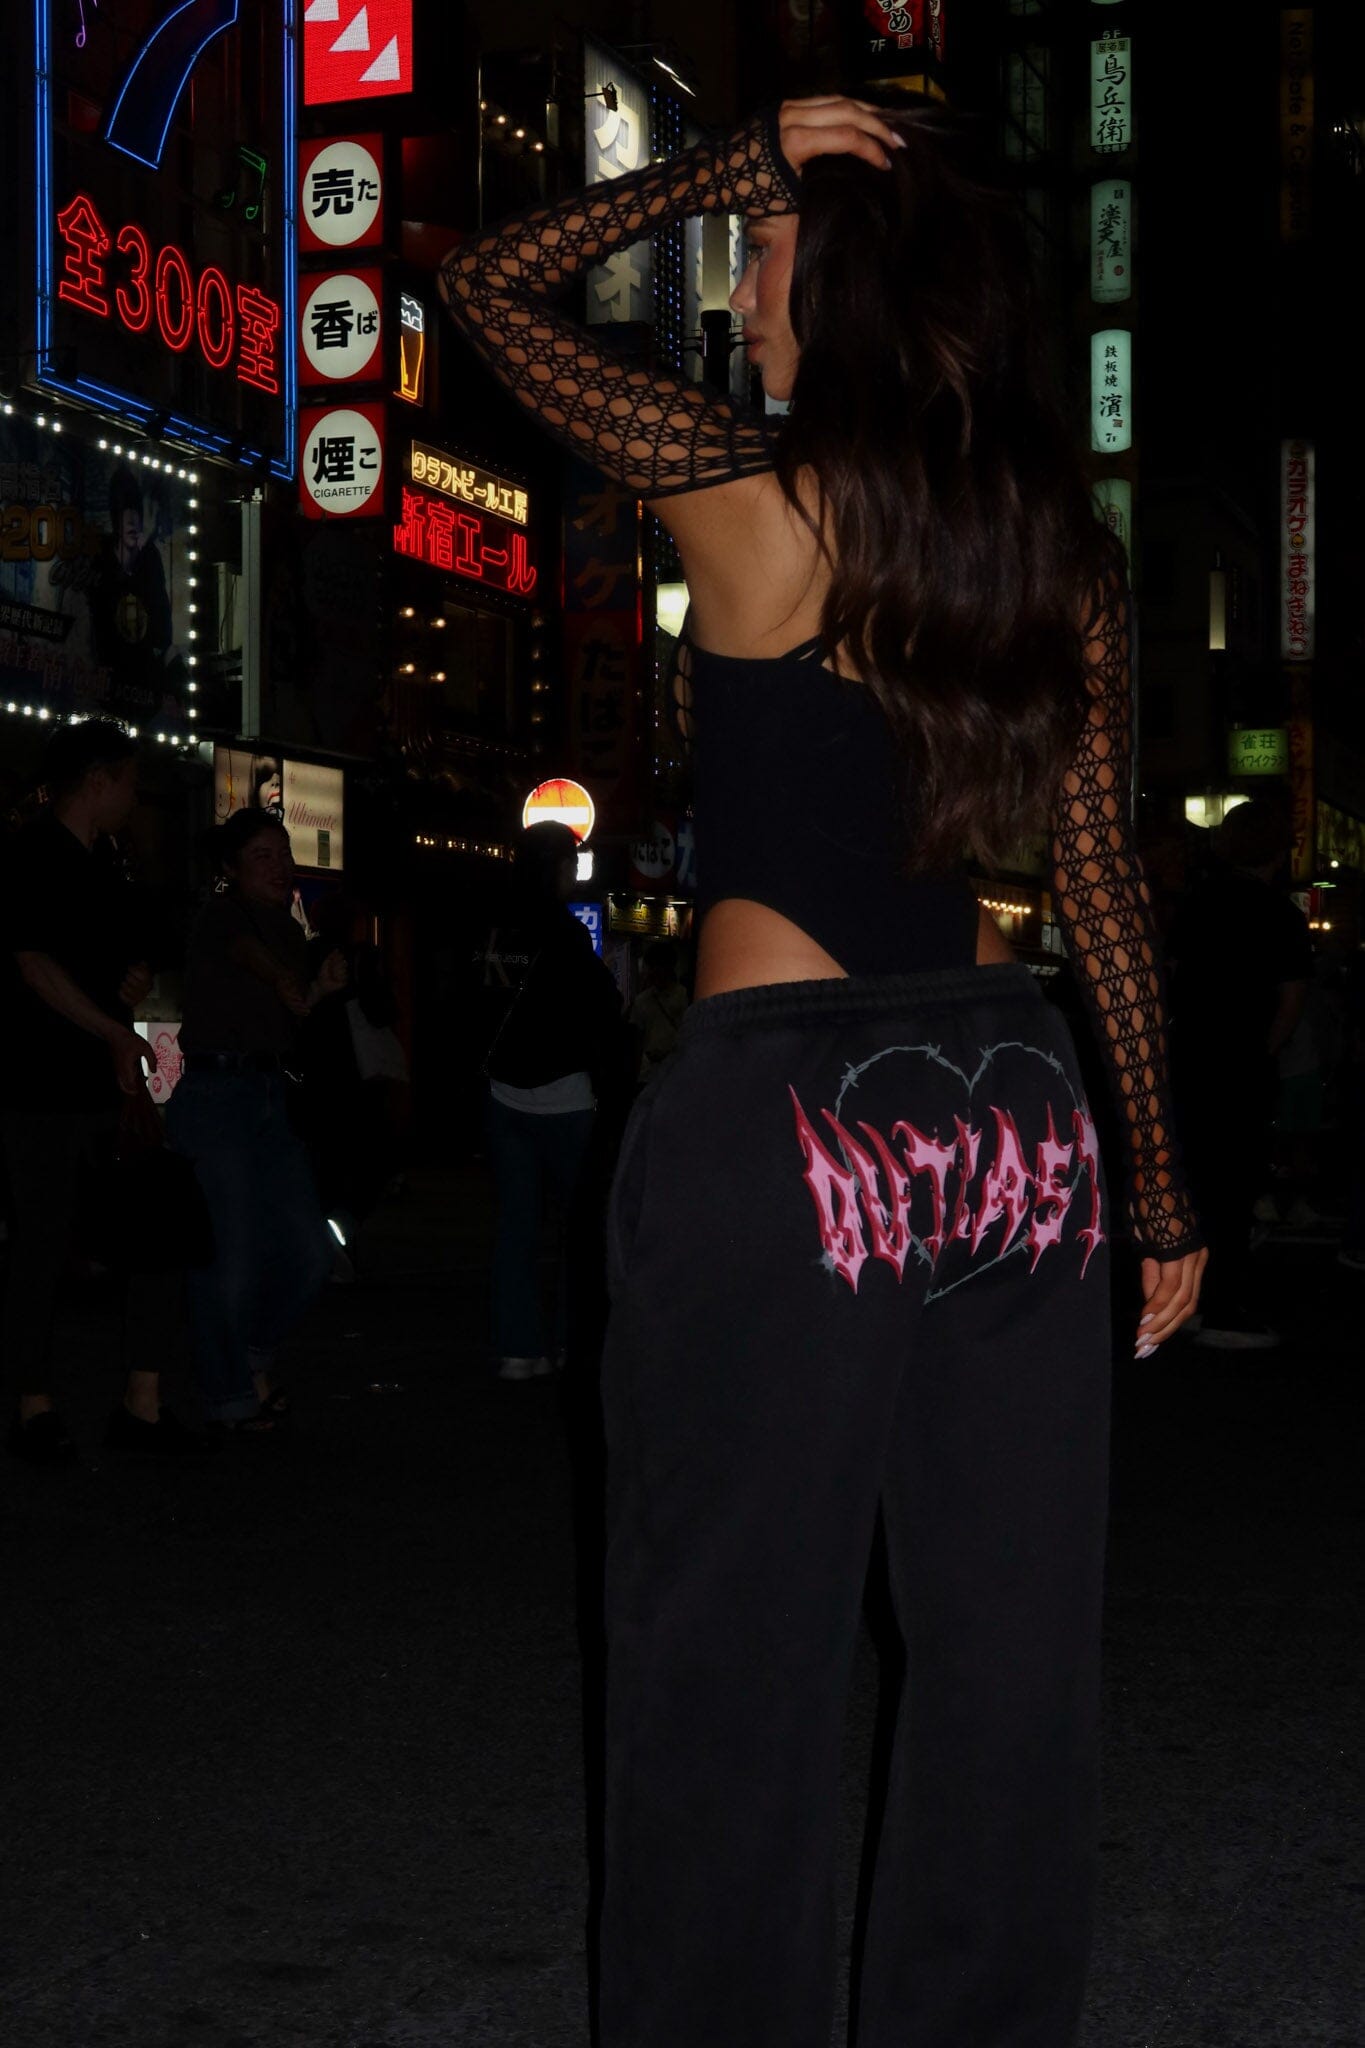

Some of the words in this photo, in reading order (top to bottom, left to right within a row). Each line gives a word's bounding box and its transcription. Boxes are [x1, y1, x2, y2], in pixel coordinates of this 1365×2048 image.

[869, 38, 887, 53] 7F
[58, 194, 279, 396] 全300室
[1104, 344, 1119, 388] 鉄板焼
[313, 486, 372, 501] CIGARETTE
[413, 451, 528, 524] クラフトビール工房
[1289, 458, 1308, 534] カラオケ
[393, 486, 538, 593] 新宿エール
[1240, 733, 1277, 750] 雀荘
